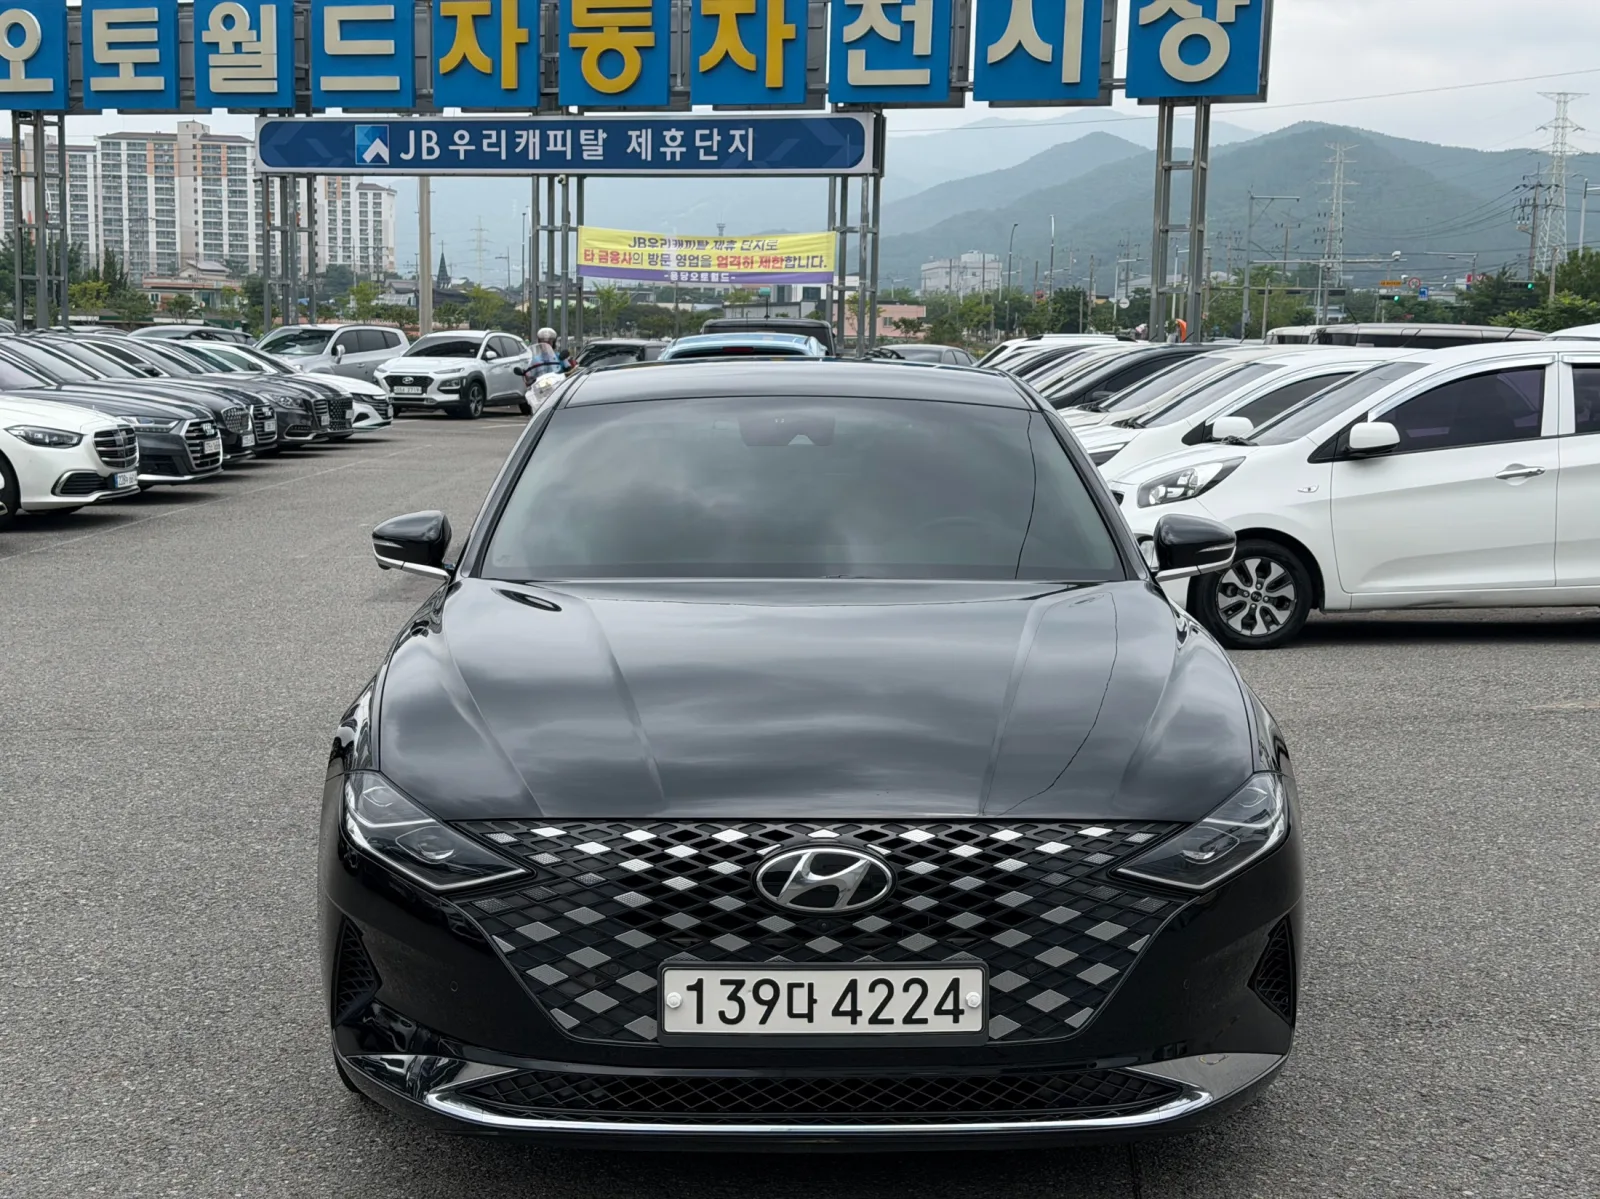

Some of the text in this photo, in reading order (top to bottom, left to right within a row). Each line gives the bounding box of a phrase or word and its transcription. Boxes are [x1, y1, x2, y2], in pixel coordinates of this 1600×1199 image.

[626, 127, 755, 162] 제휴단지
[583, 249, 828, 270] 타 금융사의 방문 영업을 엄격히 제한합니다.
